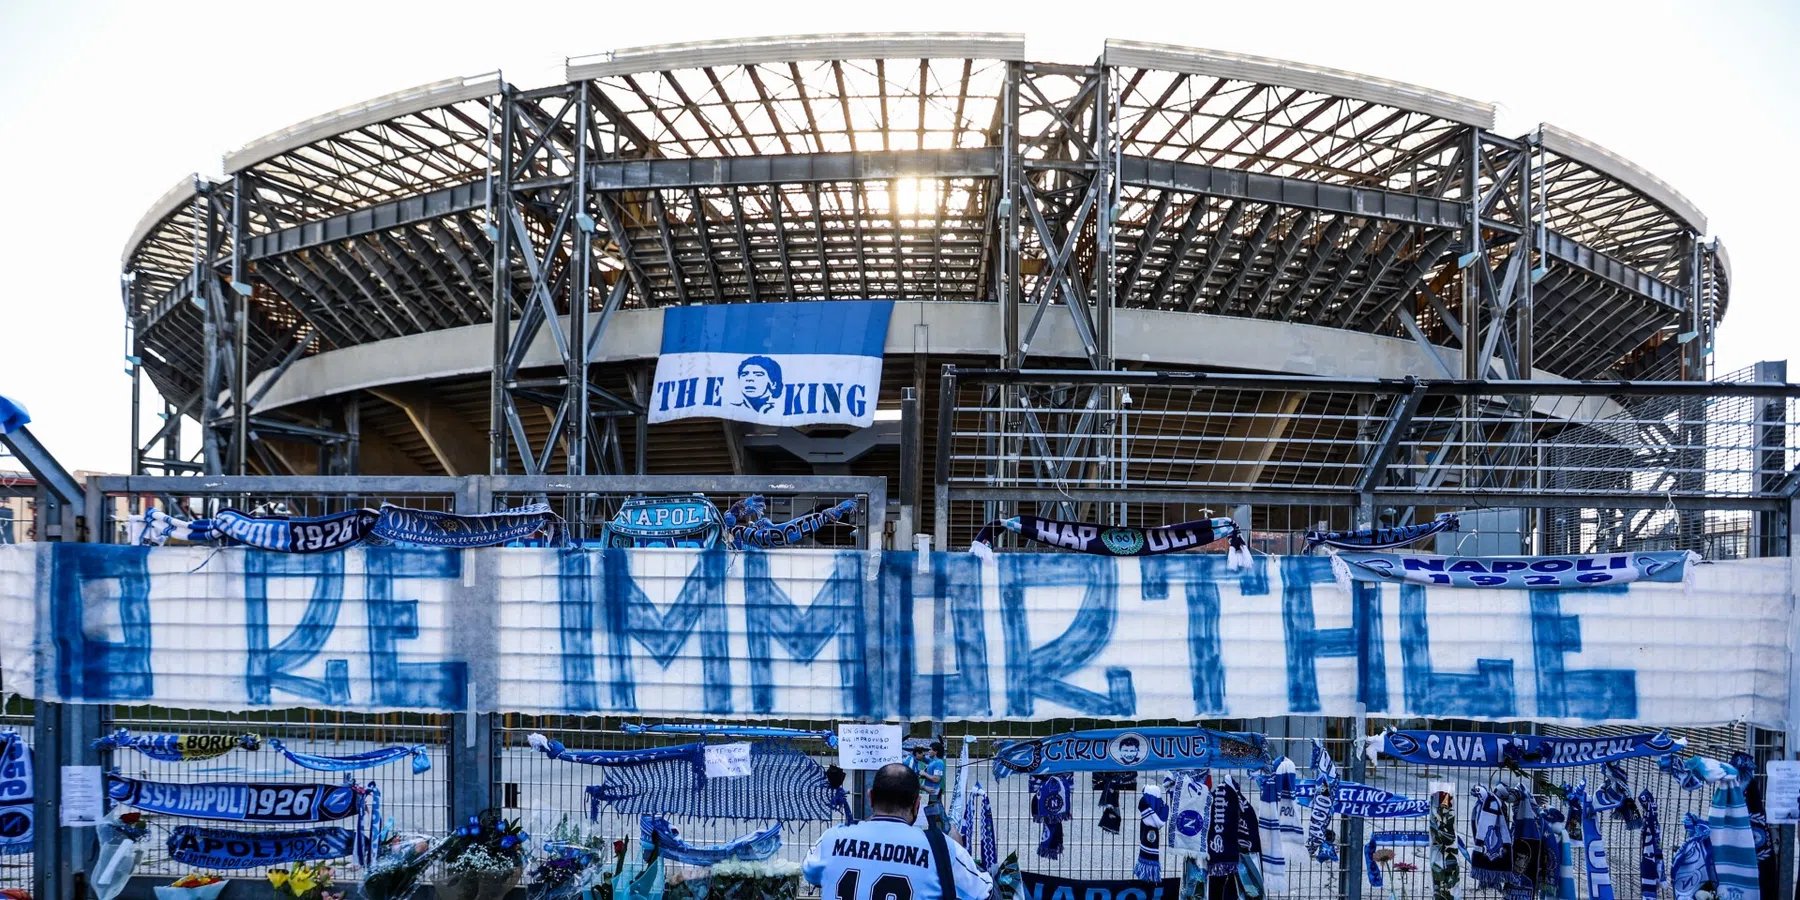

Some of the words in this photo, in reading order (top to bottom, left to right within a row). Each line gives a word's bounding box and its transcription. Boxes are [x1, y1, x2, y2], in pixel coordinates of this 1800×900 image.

[657, 377, 724, 412] THE
[783, 383, 866, 417] KING
[620, 506, 711, 526] NAPOLI
[293, 515, 357, 552] 1926
[1401, 555, 1628, 575] NAPOLI
[1428, 571, 1613, 587] 1926
[244, 546, 469, 710] RE
[558, 546, 1638, 720] IMMORTALE
[1045, 738, 1109, 761] CIRO
[1149, 736, 1207, 759] VIVE
[1426, 734, 1486, 762] CAVA
[141, 783, 177, 809] SSC
[177, 784, 246, 814] NAPOLI
[248, 789, 314, 816] 1926
[1340, 802, 1371, 816] PER
[287, 838, 330, 857] 1926
[832, 838, 929, 869] MARADONA
